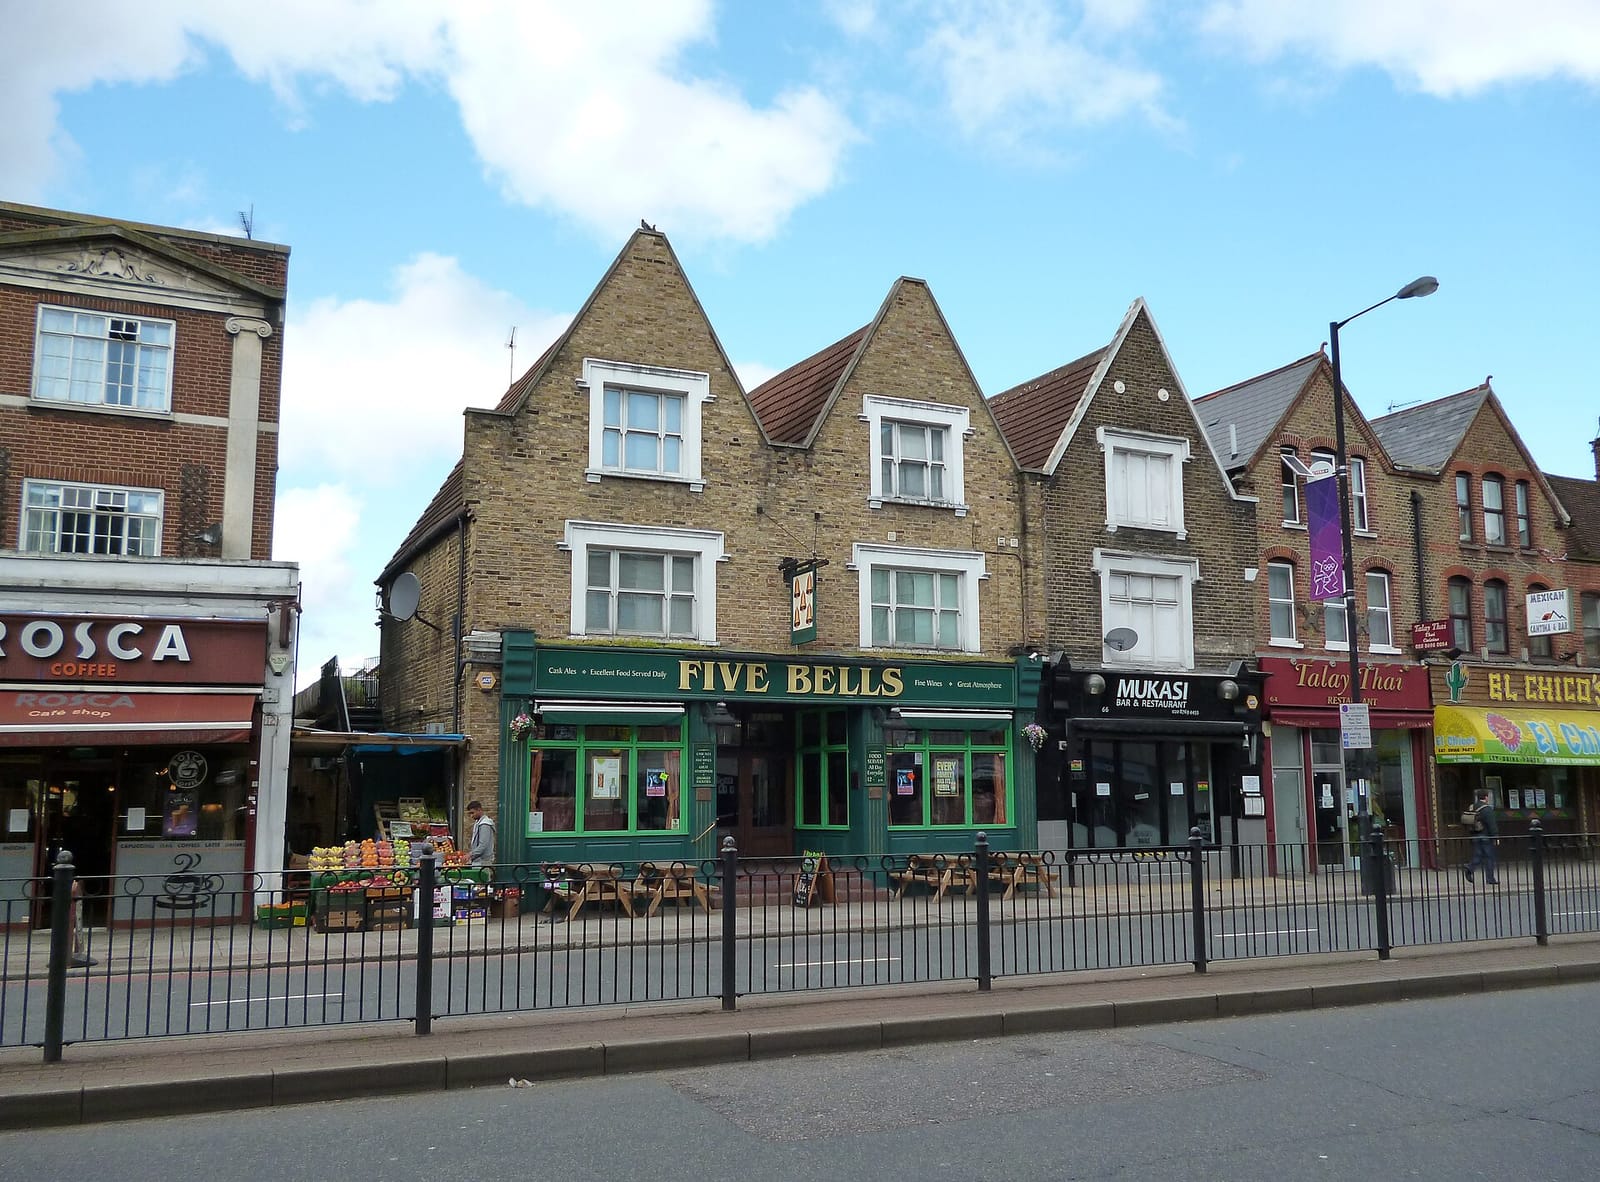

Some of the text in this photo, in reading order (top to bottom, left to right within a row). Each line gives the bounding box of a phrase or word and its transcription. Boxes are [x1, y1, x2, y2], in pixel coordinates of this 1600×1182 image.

[1530, 591, 1565, 603] MEXICAN
[1414, 621, 1447, 633] Talay Thai
[0, 620, 191, 662] OSCA
[51, 662, 117, 677] COFFEE
[548, 666, 563, 674] Cask
[590, 668, 615, 676] Excellent
[652, 670, 667, 679] Daily
[678, 660, 904, 697] FIVE BELLS
[914, 679, 926, 687] Fine
[972, 681, 1002, 691] Atmosphere
[1295, 663, 1403, 696] Talay Thai
[1116, 679, 1189, 700] MUKASI
[1487, 672, 1518, 701] EL
[15, 693, 135, 708] ROSCA
[1115, 698, 1187, 709] BAR & RESTAURANT
[1327, 696, 1378, 706] RESTAANT
[72, 708, 111, 718] shop
[1526, 721, 1559, 754] El
[936, 761, 956, 771] EVERY
